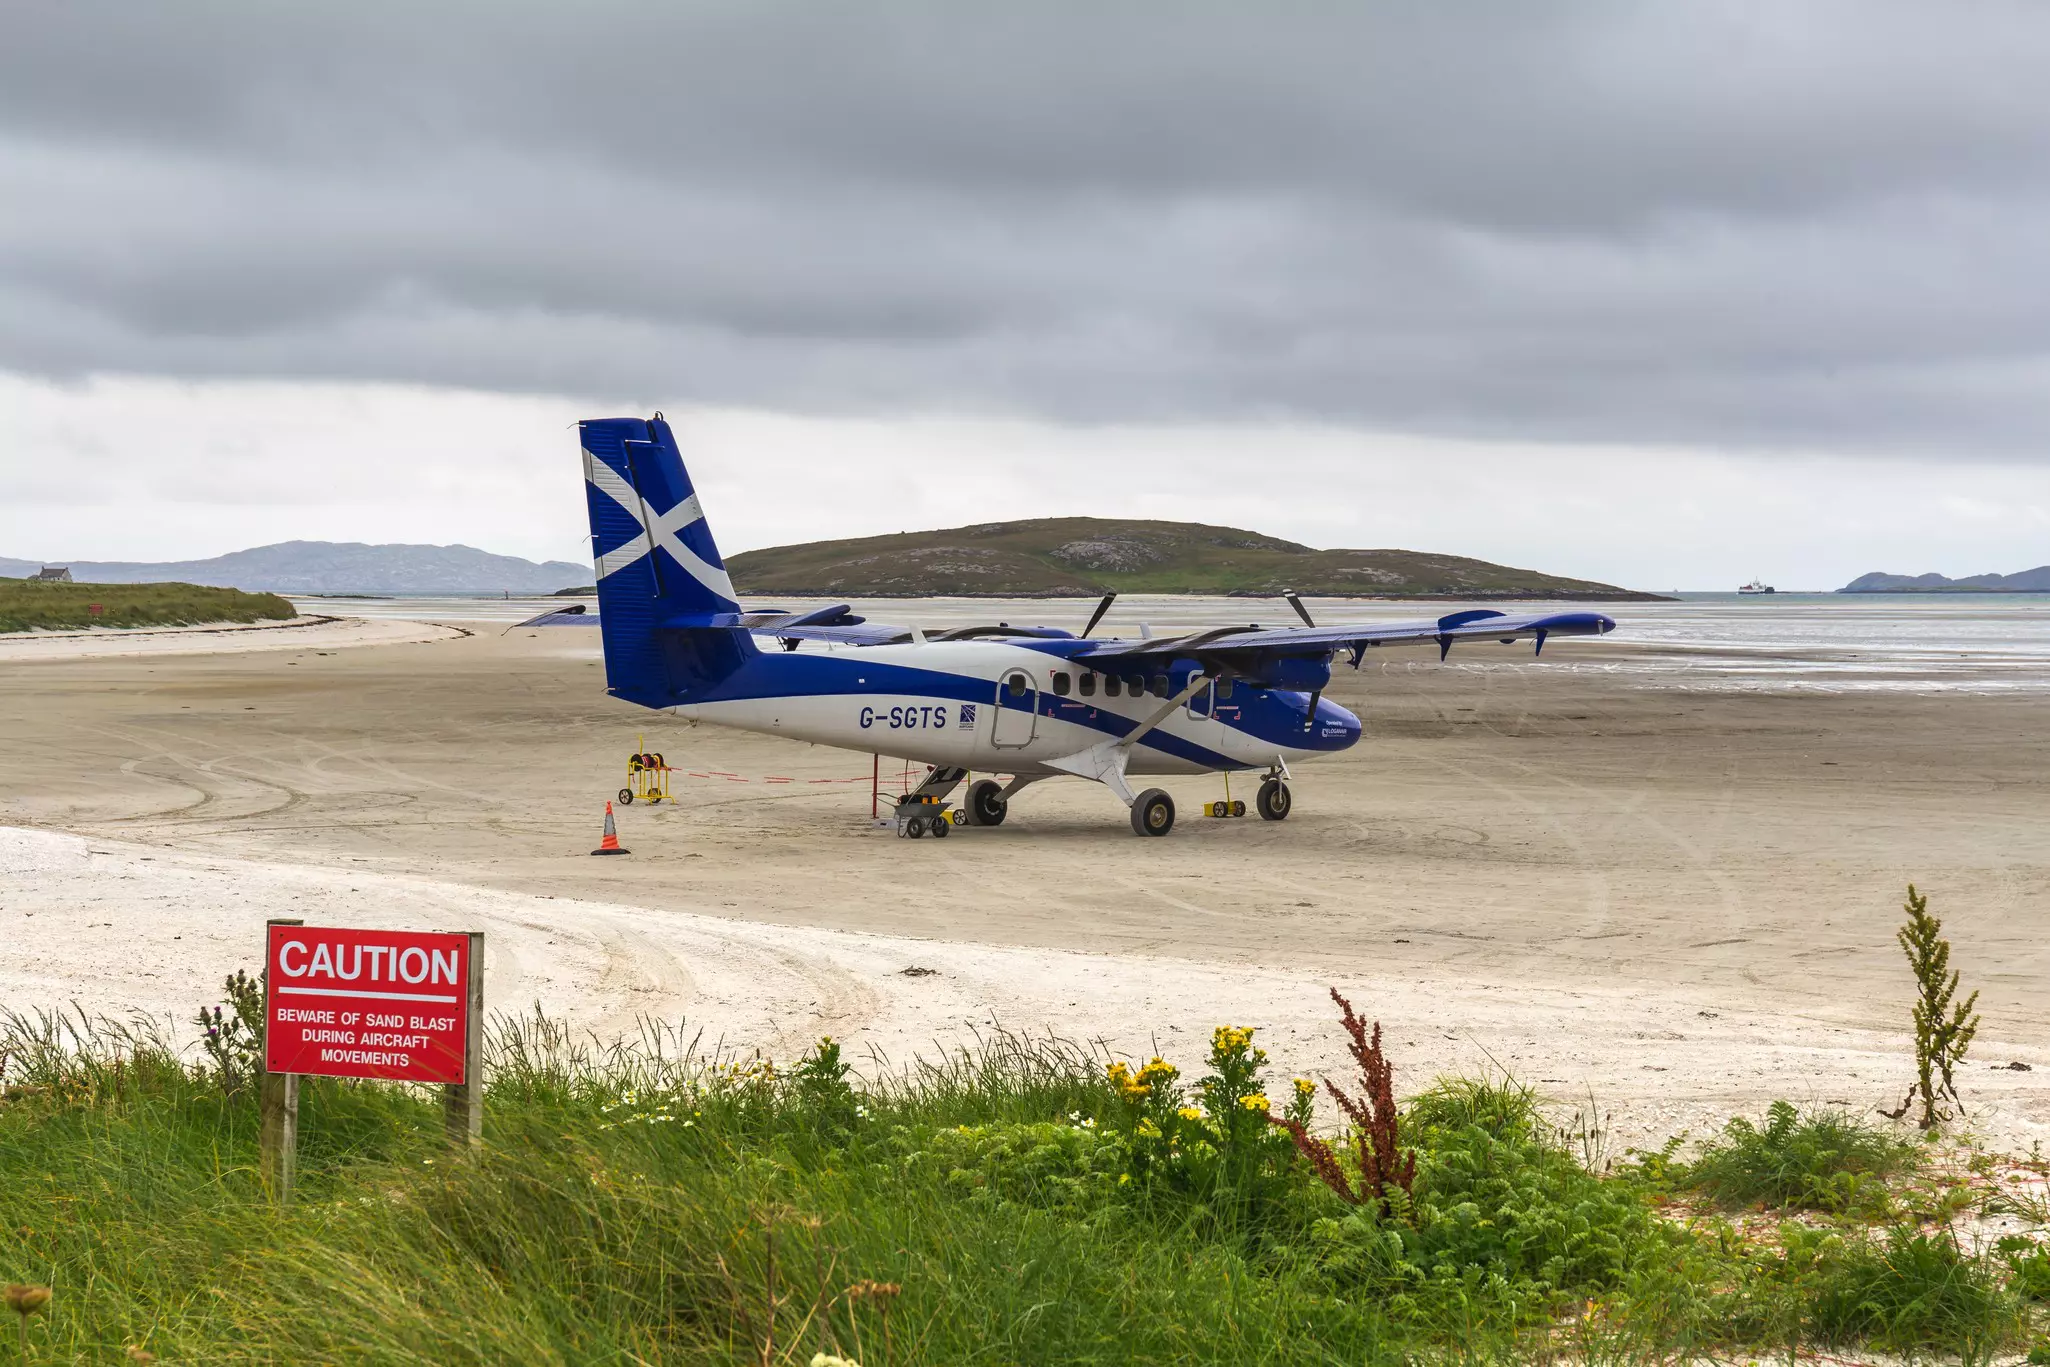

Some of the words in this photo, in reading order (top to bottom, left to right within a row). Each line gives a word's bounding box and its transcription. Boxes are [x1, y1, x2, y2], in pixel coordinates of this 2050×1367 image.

[860, 707, 946, 728] G-SGTS
[280, 941, 458, 984] CAUTION
[278, 1009, 335, 1023] BEWARE
[341, 1012, 360, 1025] OF
[366, 1014, 404, 1028] SAND
[410, 1016, 455, 1031] BLAST
[303, 1029, 354, 1044] DURING
[361, 1033, 429, 1048] AIRCRAFT
[322, 1049, 409, 1066] MOVEMENTS
